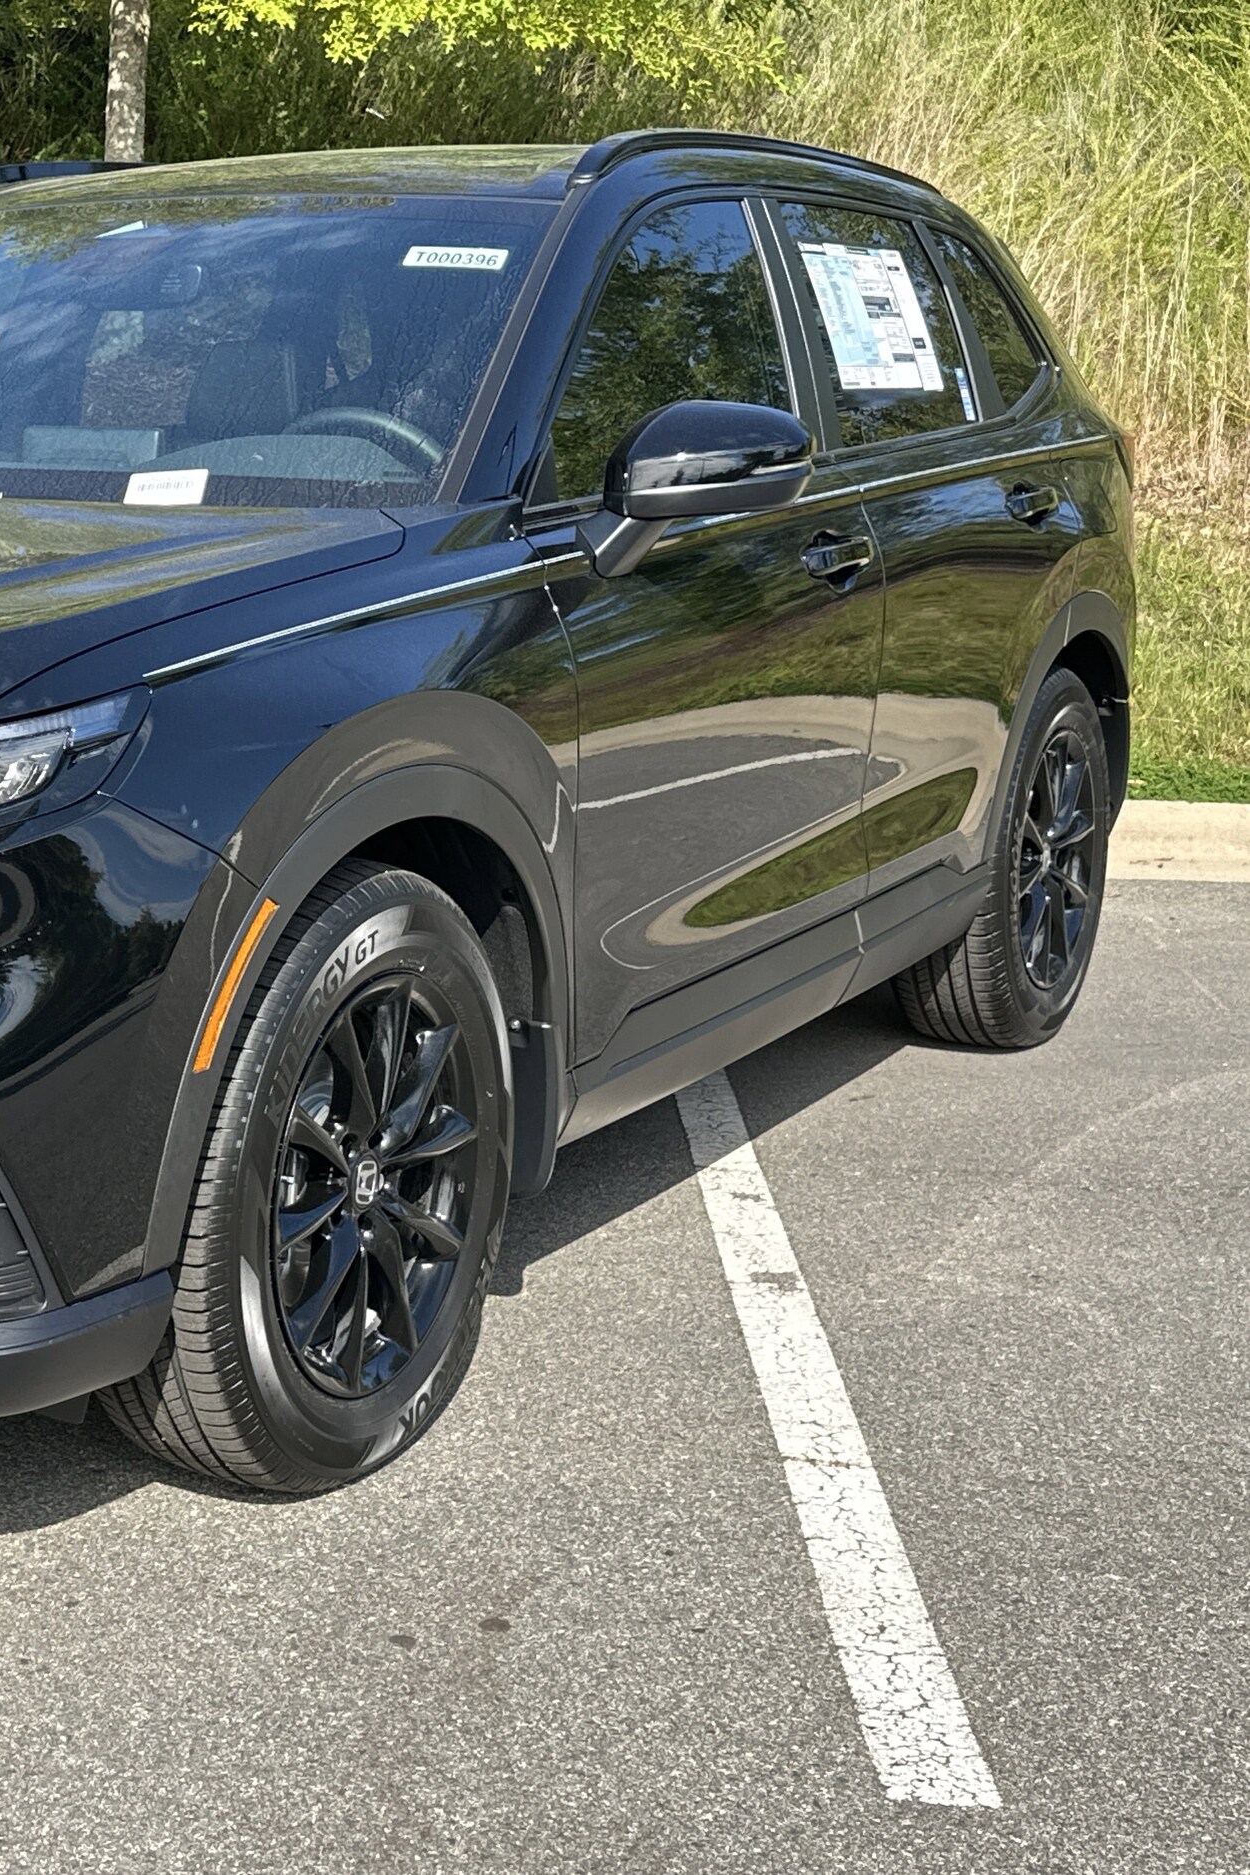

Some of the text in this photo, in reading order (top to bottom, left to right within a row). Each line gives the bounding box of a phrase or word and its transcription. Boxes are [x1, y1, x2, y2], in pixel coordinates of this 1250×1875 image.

[416, 251, 499, 267] T000396
[264, 929, 379, 1130] KINERGY GT
